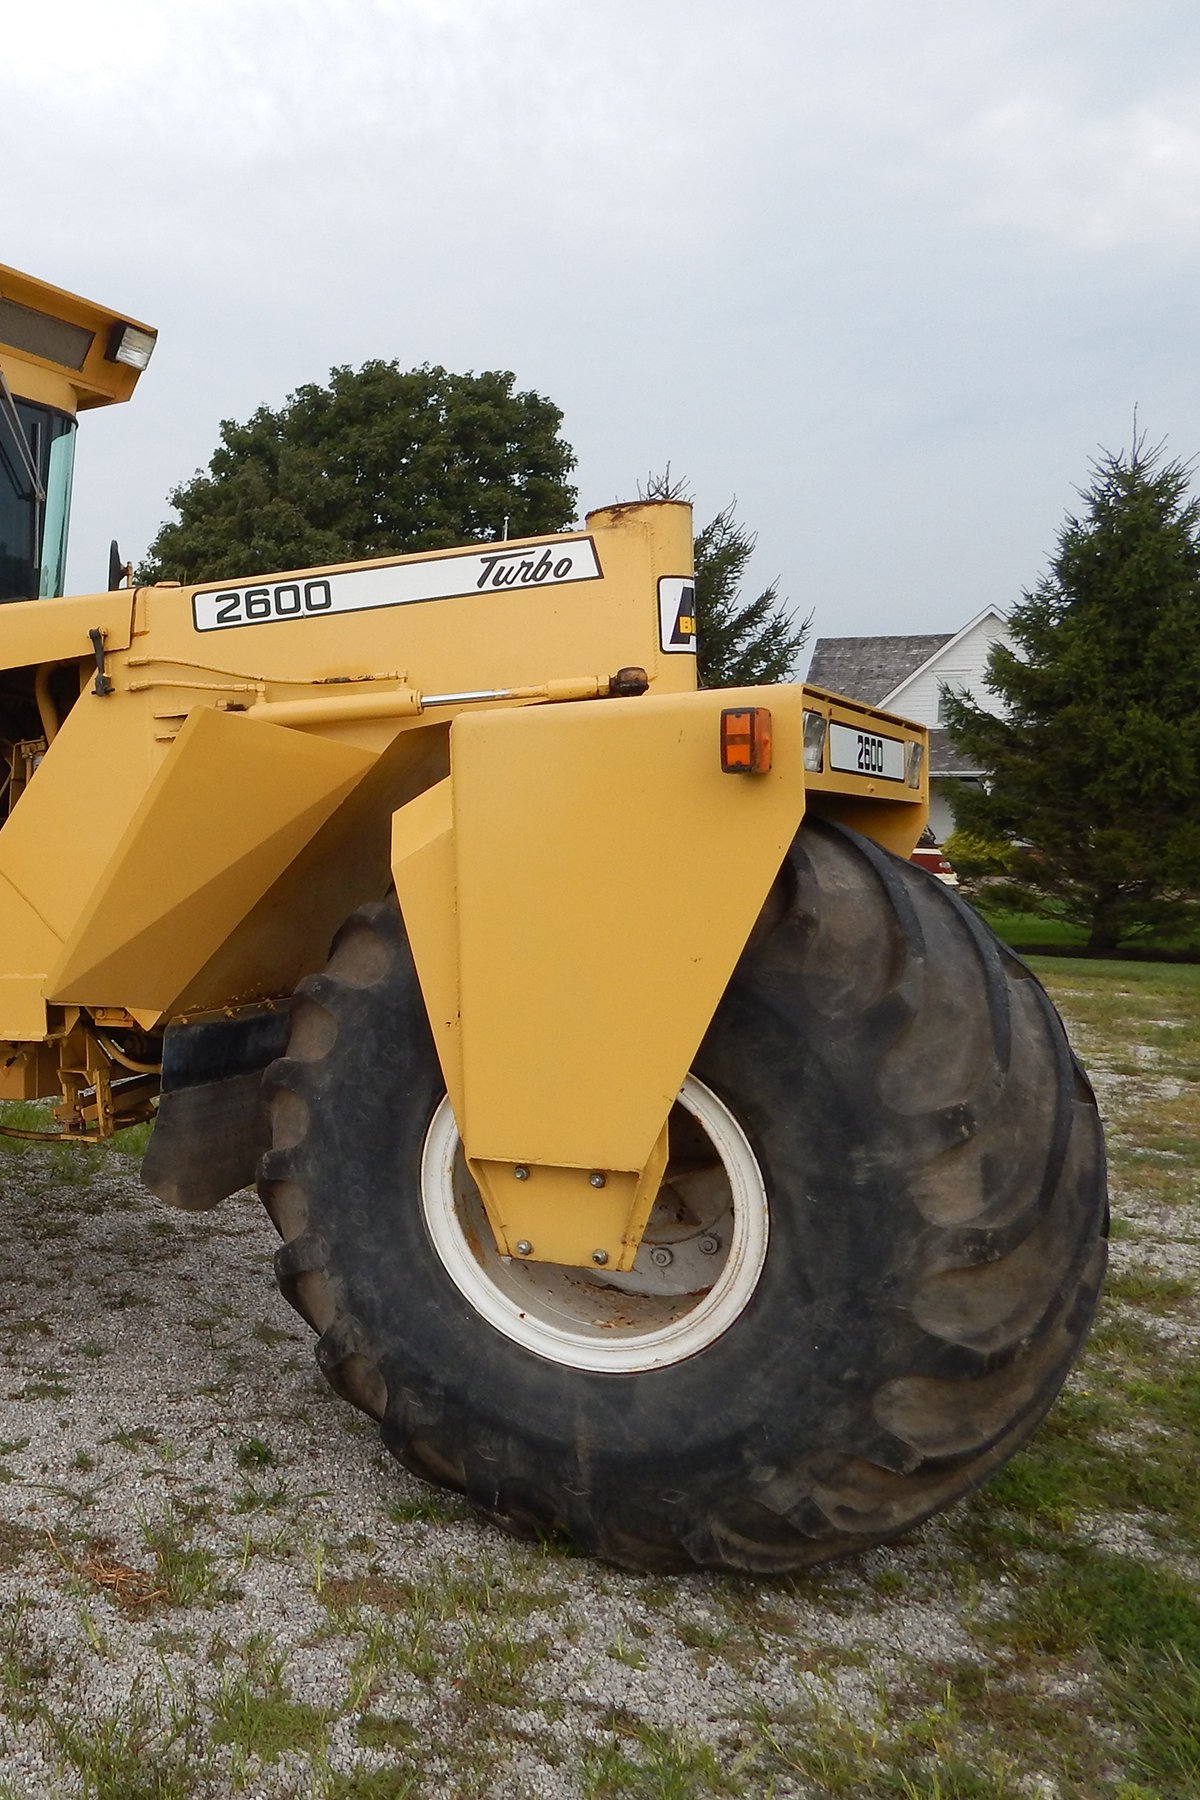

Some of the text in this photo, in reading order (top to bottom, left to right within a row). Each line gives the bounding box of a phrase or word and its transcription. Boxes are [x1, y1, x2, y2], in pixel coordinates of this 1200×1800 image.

[215, 549, 573, 624] 2600 Turbo
[857, 735, 883, 772] 2600
